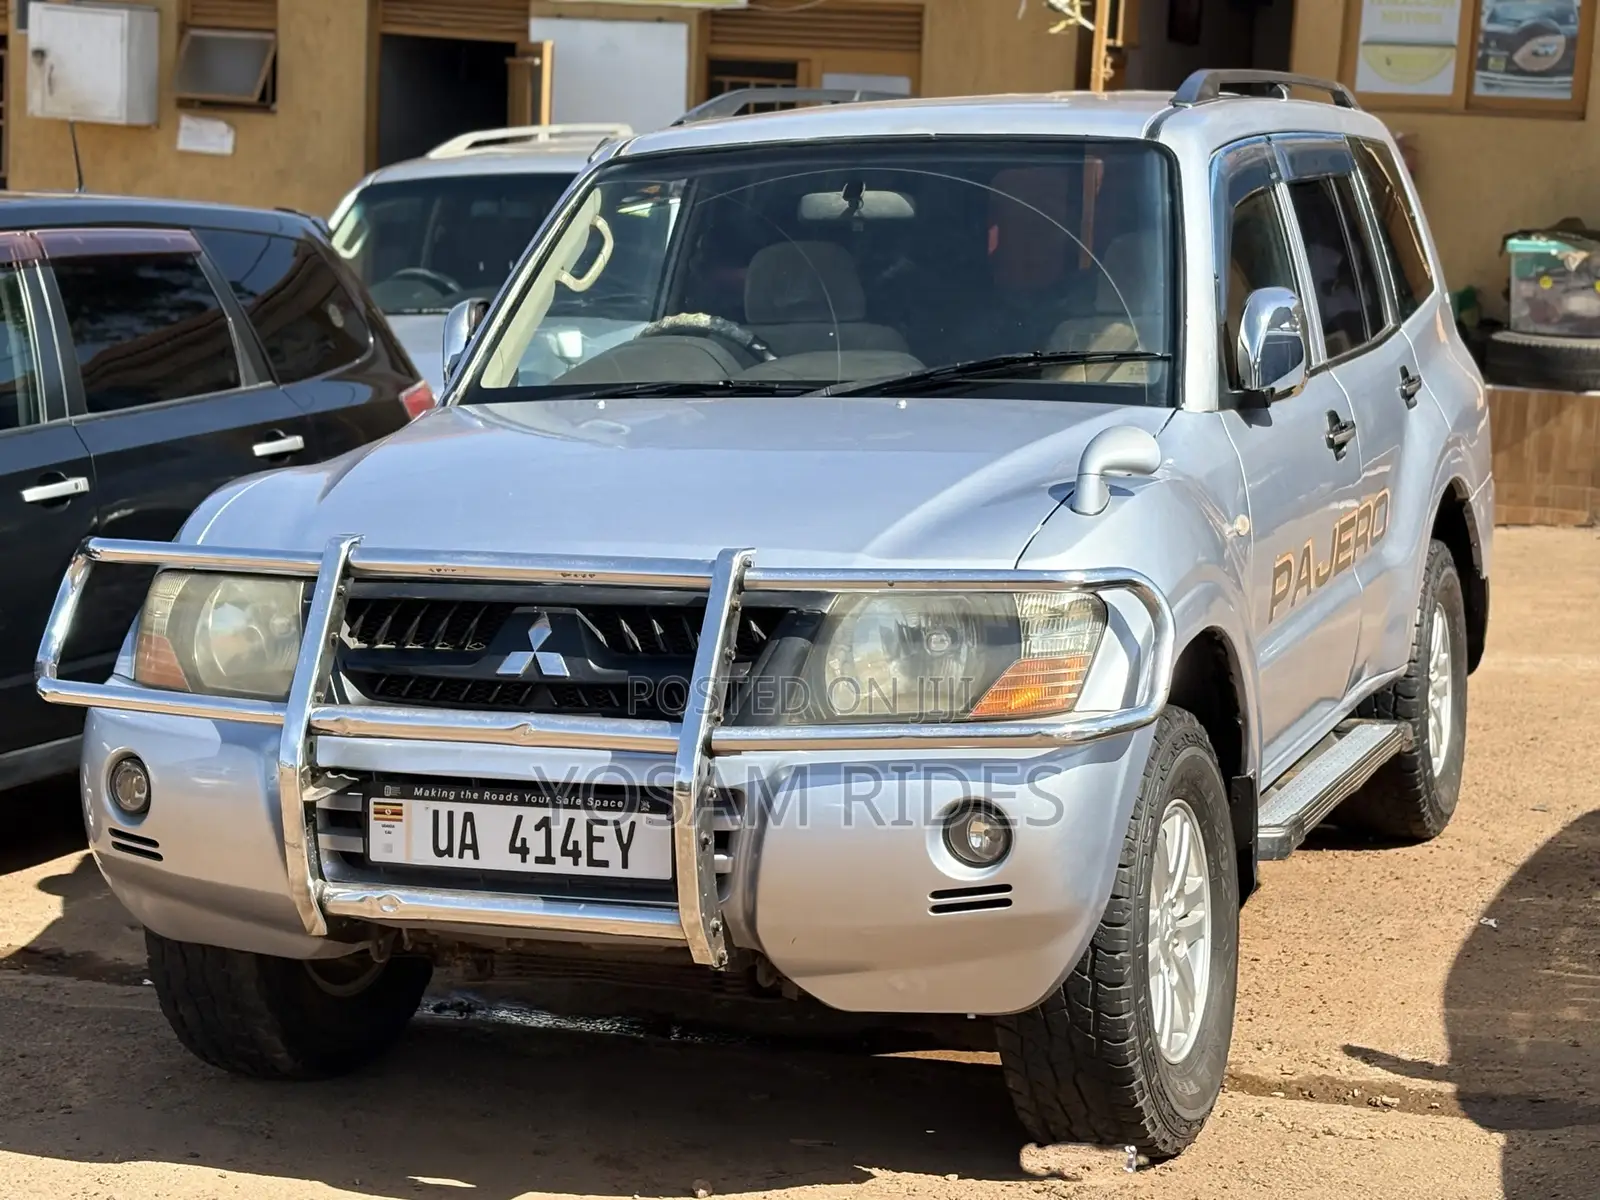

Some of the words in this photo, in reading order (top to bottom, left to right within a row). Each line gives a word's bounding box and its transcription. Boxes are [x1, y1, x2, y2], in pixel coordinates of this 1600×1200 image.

[1268, 487, 1391, 625] PAJERO
[413, 787, 456, 800] Making
[460, 790, 479, 800] the
[484, 791, 519, 802] Roads
[524, 793, 551, 804] Your
[555, 796, 582, 806] Safe
[587, 797, 624, 809] Space
[432, 809, 480, 860] UA
[509, 814, 636, 870] 414EY
